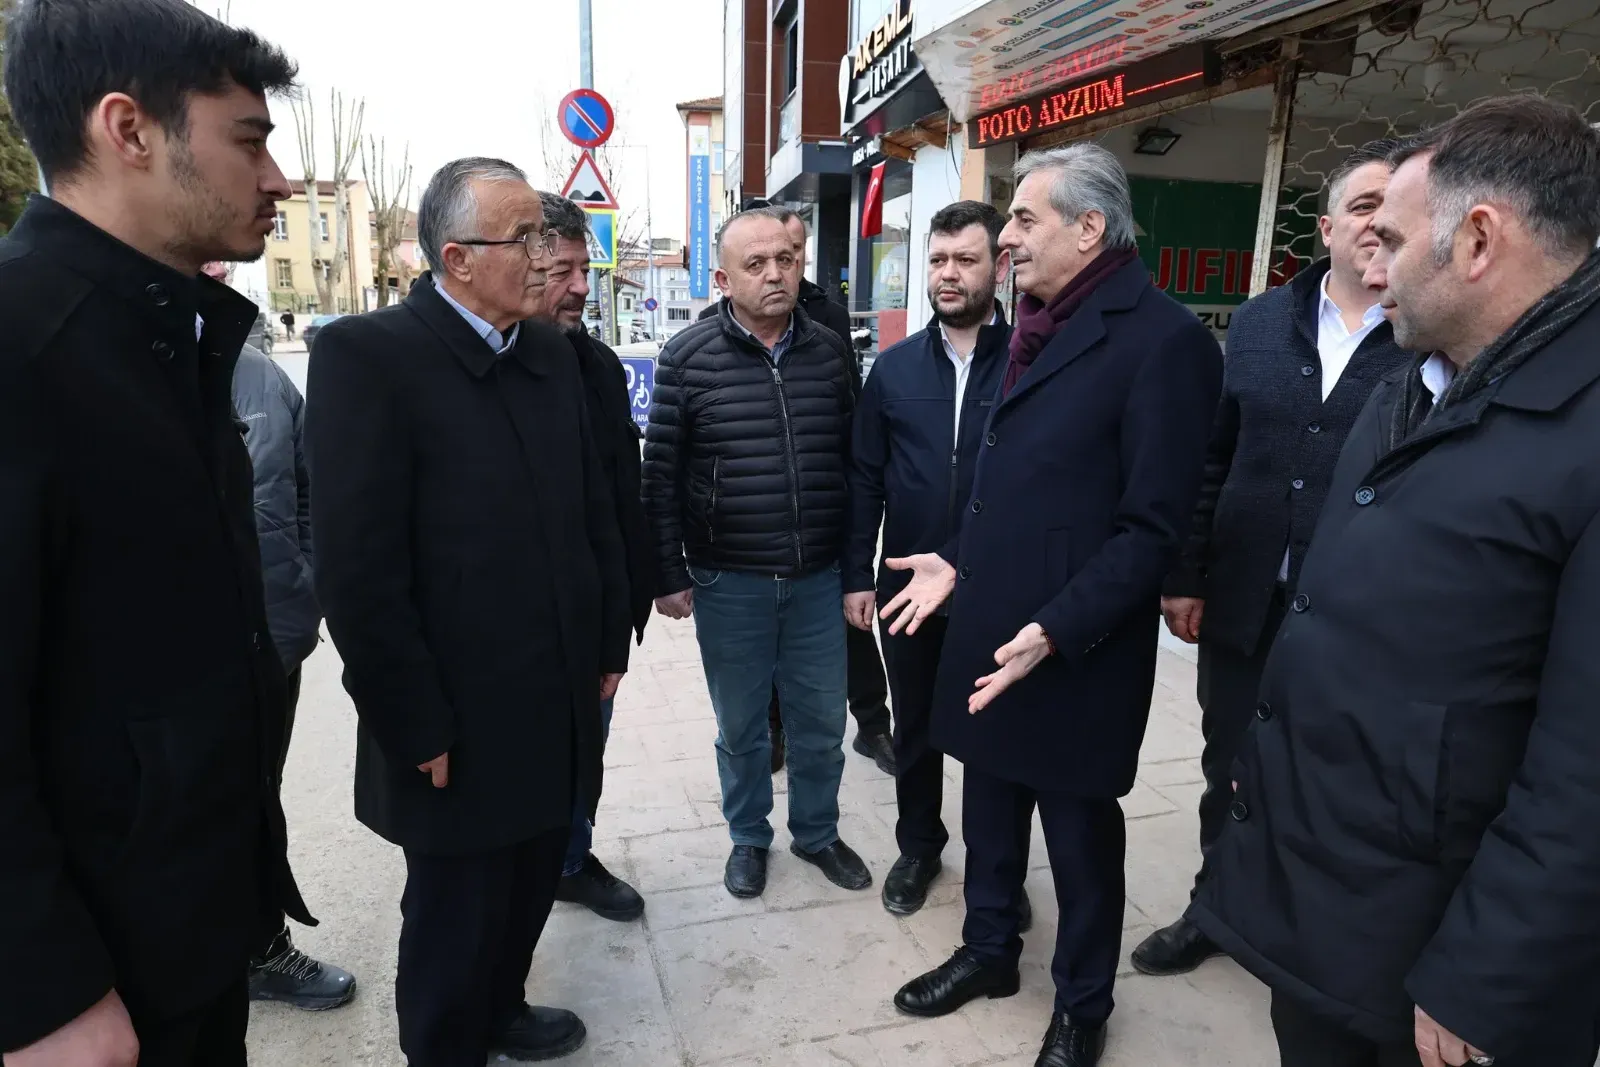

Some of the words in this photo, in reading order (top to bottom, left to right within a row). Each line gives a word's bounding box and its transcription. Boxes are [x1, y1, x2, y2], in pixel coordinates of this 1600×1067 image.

[853, 0, 913, 79] AKEML
[977, 104, 1032, 144] FOTO
[1038, 74, 1125, 127] ARZUM
